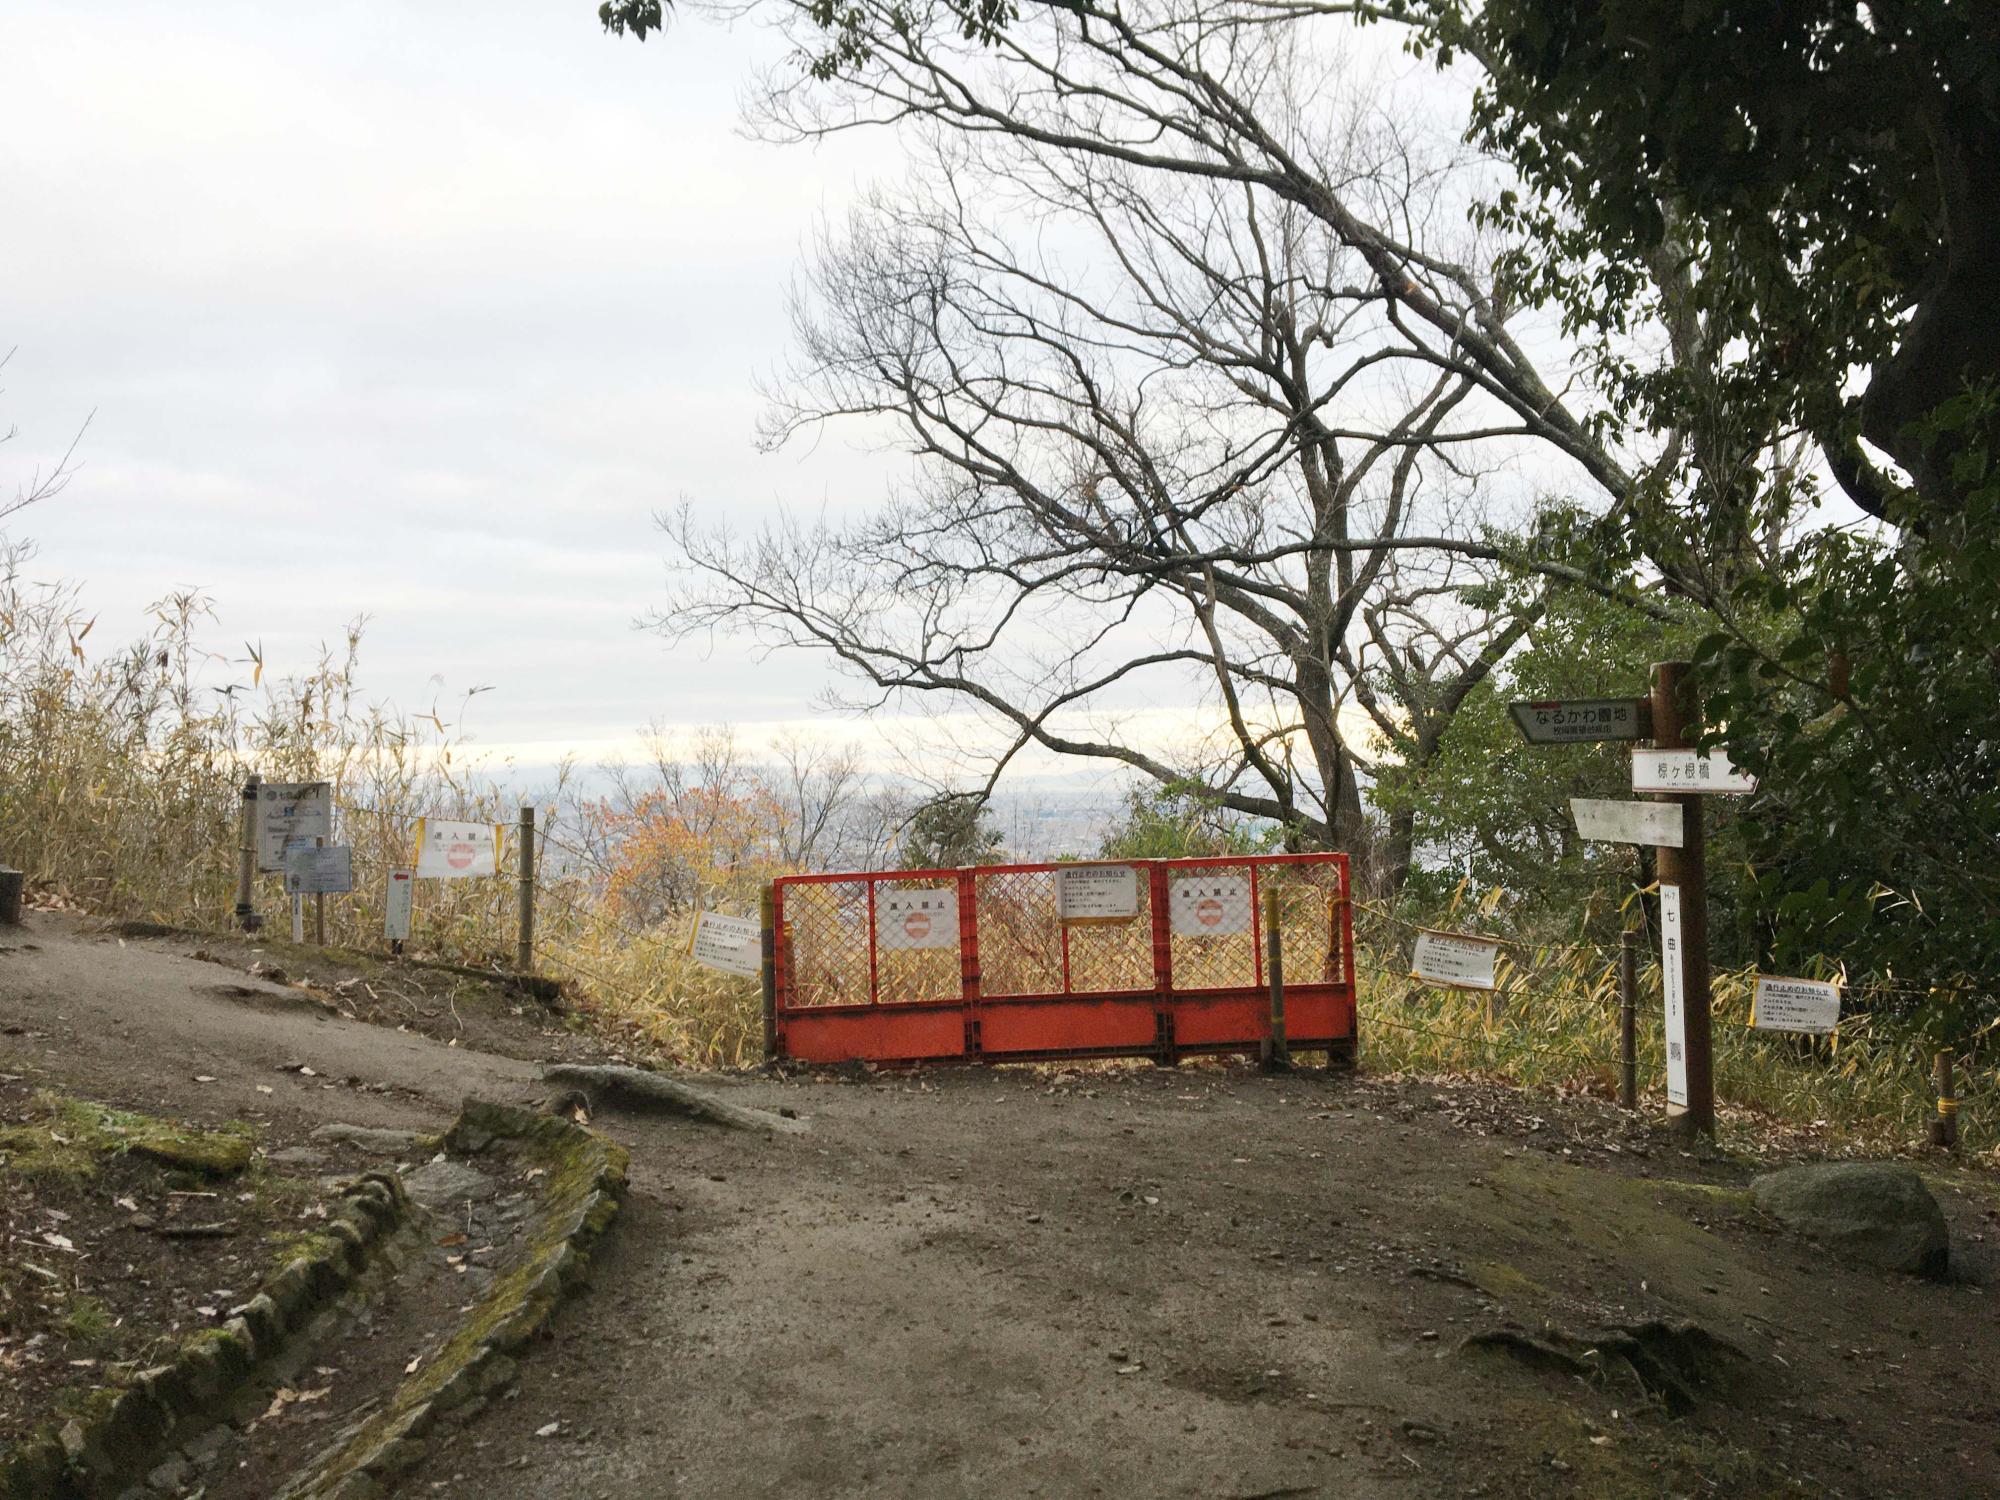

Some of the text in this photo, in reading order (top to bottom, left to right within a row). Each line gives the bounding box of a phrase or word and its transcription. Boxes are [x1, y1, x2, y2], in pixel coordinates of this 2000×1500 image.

[1536, 707, 1628, 725] なるかわ園地
[1182, 888, 1237, 898] 進入禁止
[890, 900, 945, 911] 進入禁止
